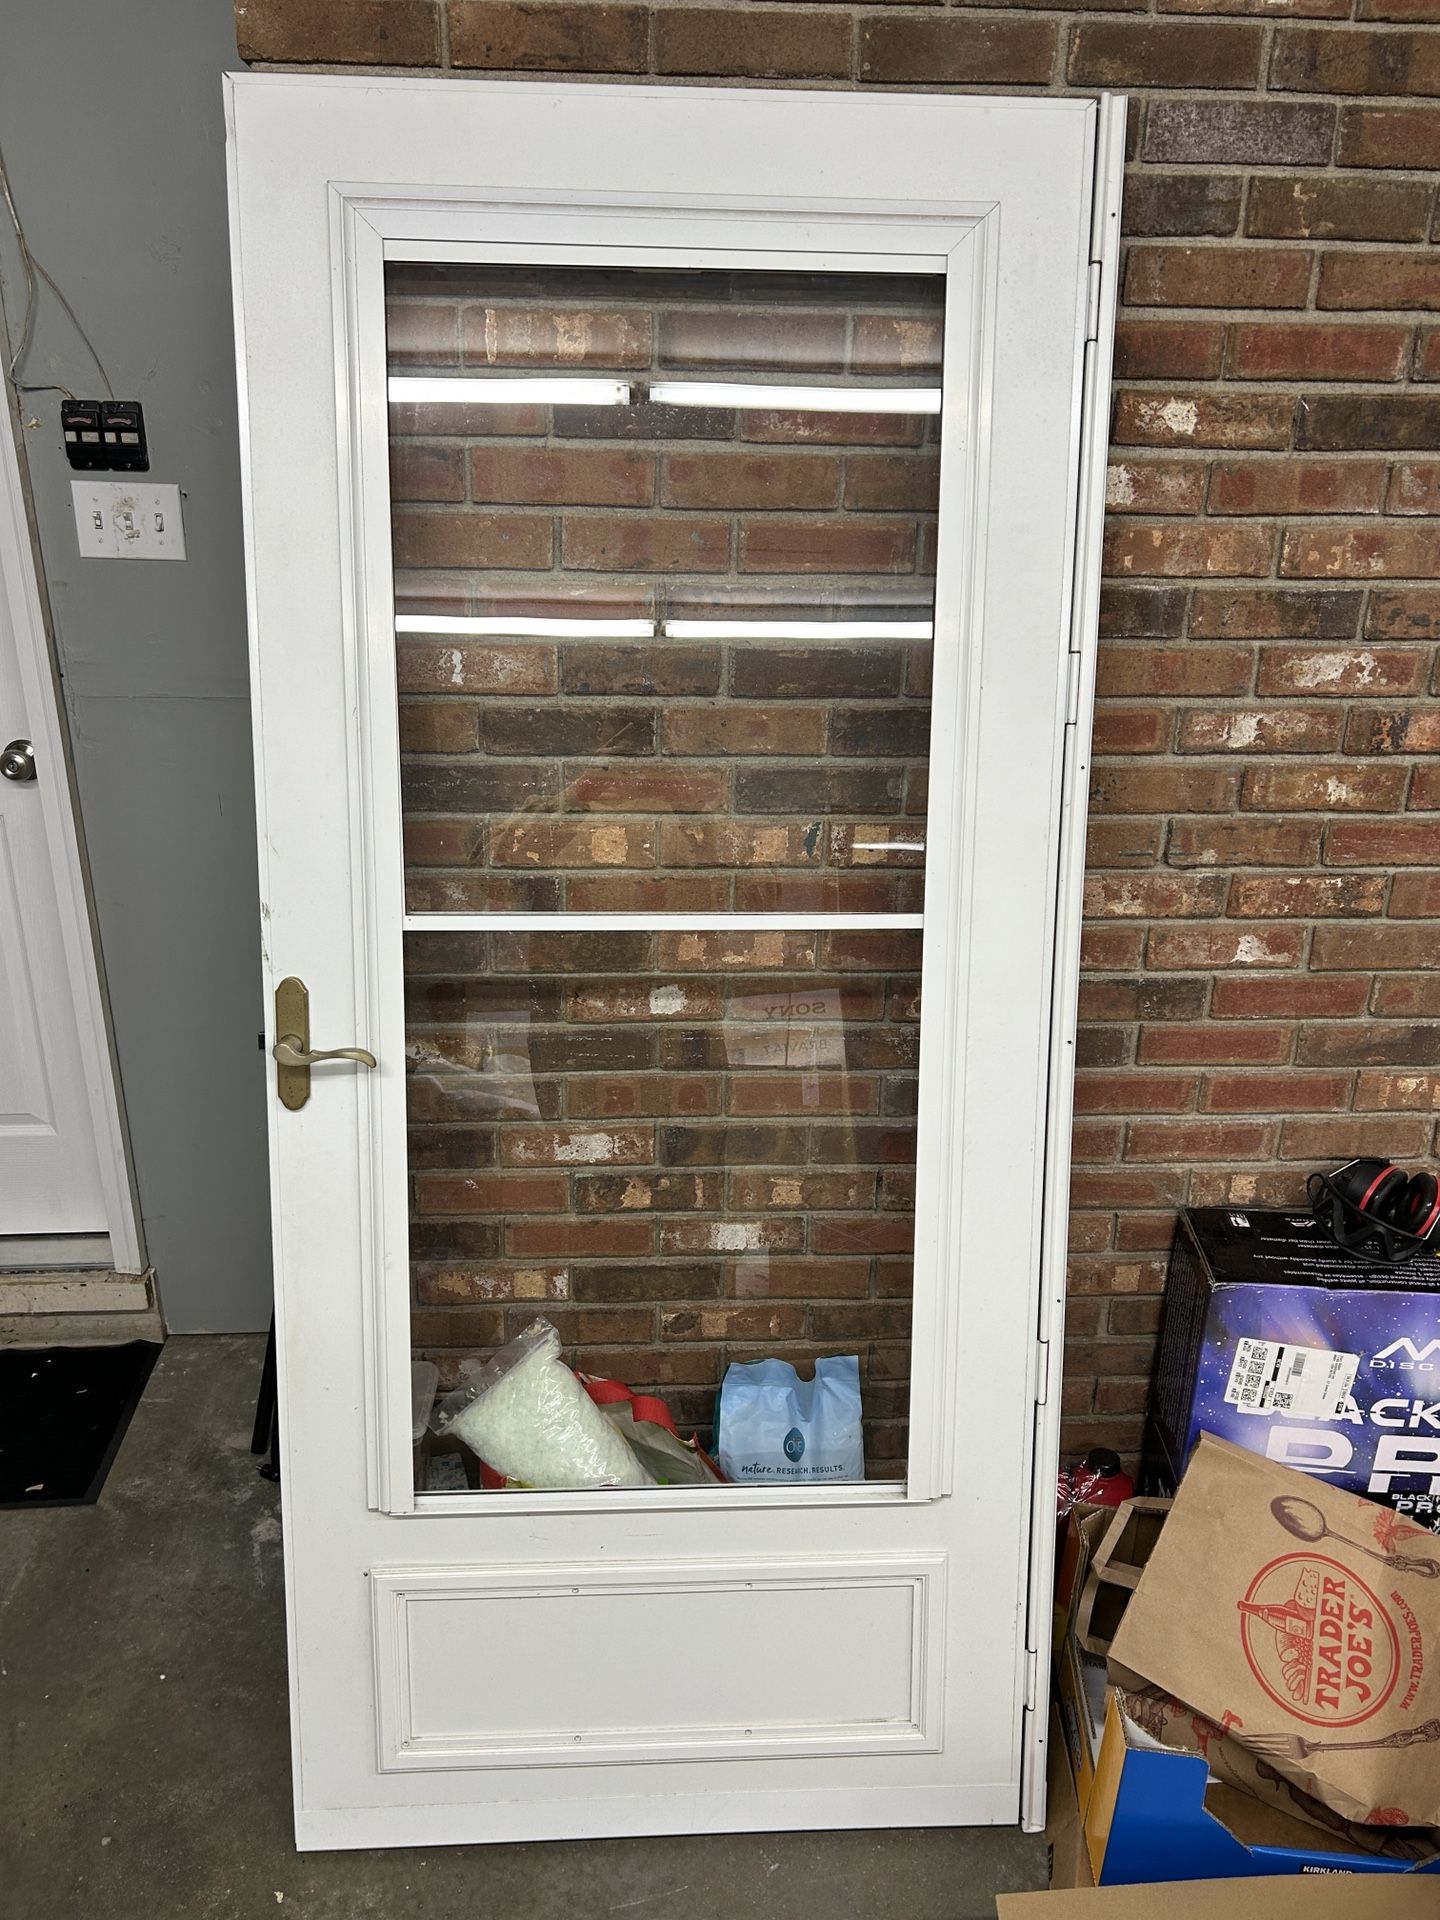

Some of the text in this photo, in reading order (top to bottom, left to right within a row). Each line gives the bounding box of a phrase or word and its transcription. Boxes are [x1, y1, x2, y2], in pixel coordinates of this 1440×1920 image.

[1369, 1359, 1435, 1371] DISC
[1391, 1493, 1431, 1502] BLACK
[1395, 1500, 1440, 1514] PR
[1315, 1576, 1346, 1710] TRADER
[1346, 1601, 1373, 1703] JOE'S
